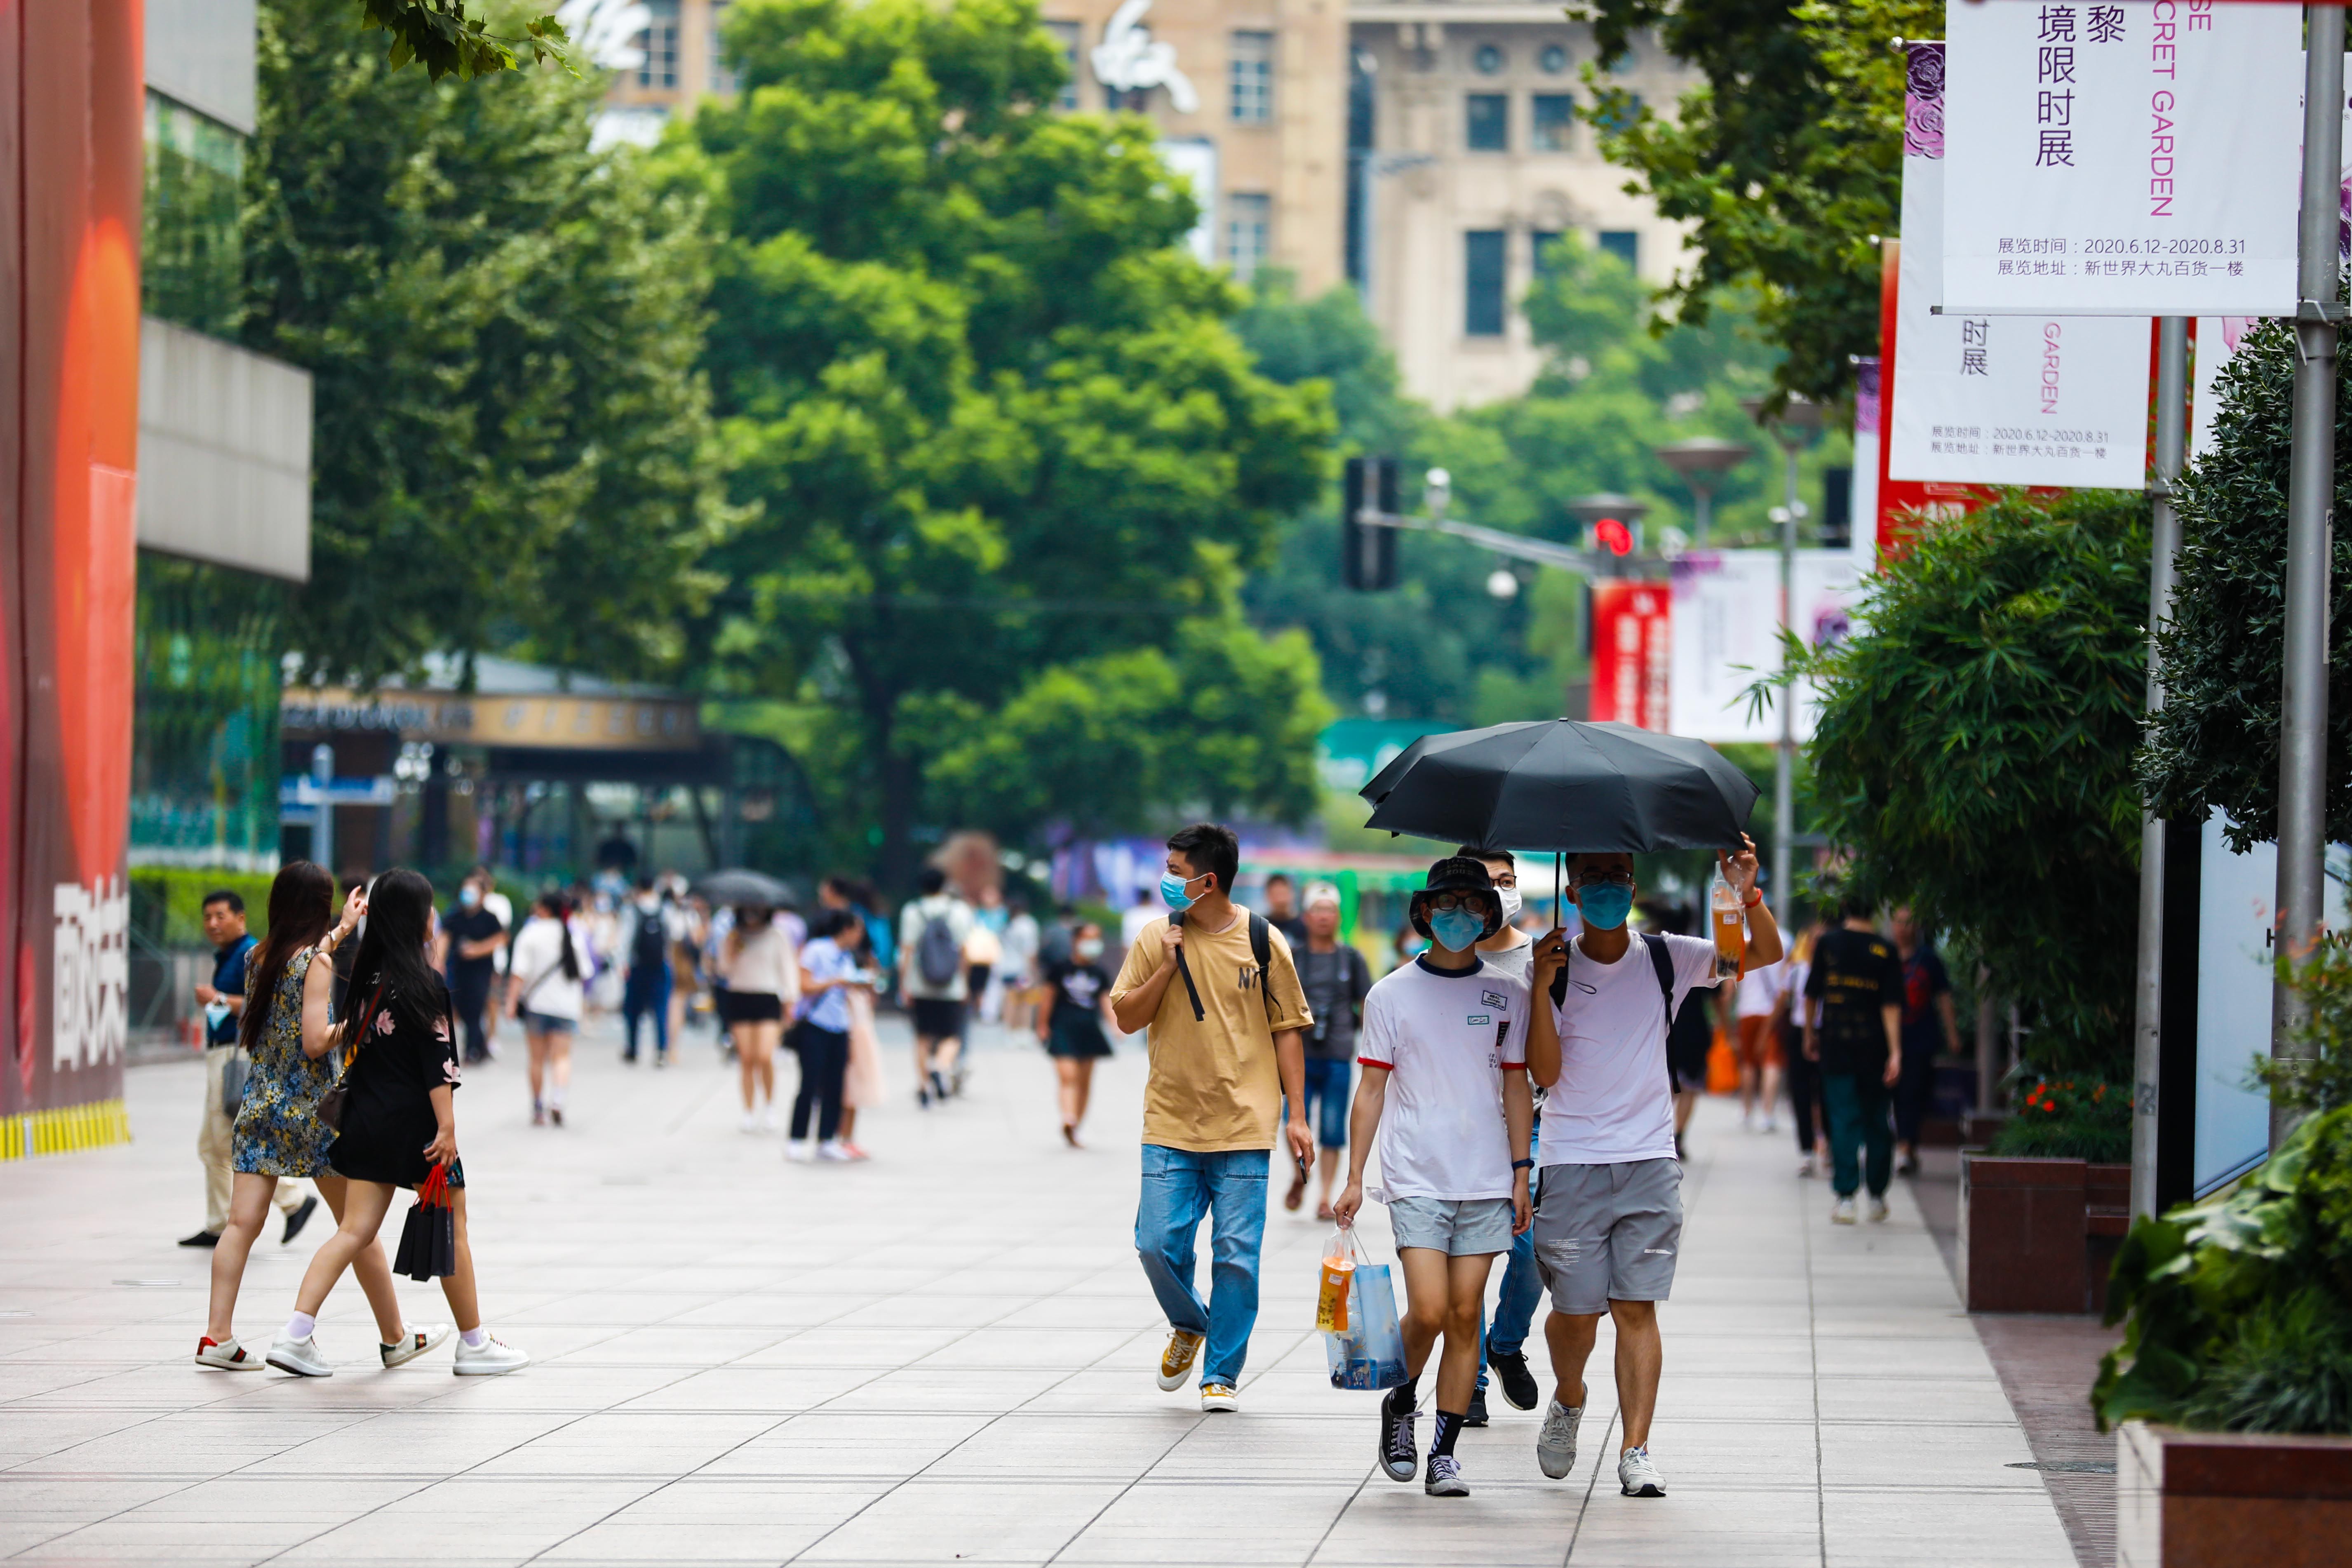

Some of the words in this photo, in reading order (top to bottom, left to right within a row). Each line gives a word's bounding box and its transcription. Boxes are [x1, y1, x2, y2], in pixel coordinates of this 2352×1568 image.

[2087, 5, 2125, 43] 黎
[2036, 5, 2076, 167] 境限时展
[2150, 90, 2174, 216] GARDEN
[1960, 319, 1990, 376] 时展
[2041, 322, 2061, 414] GARDEN
